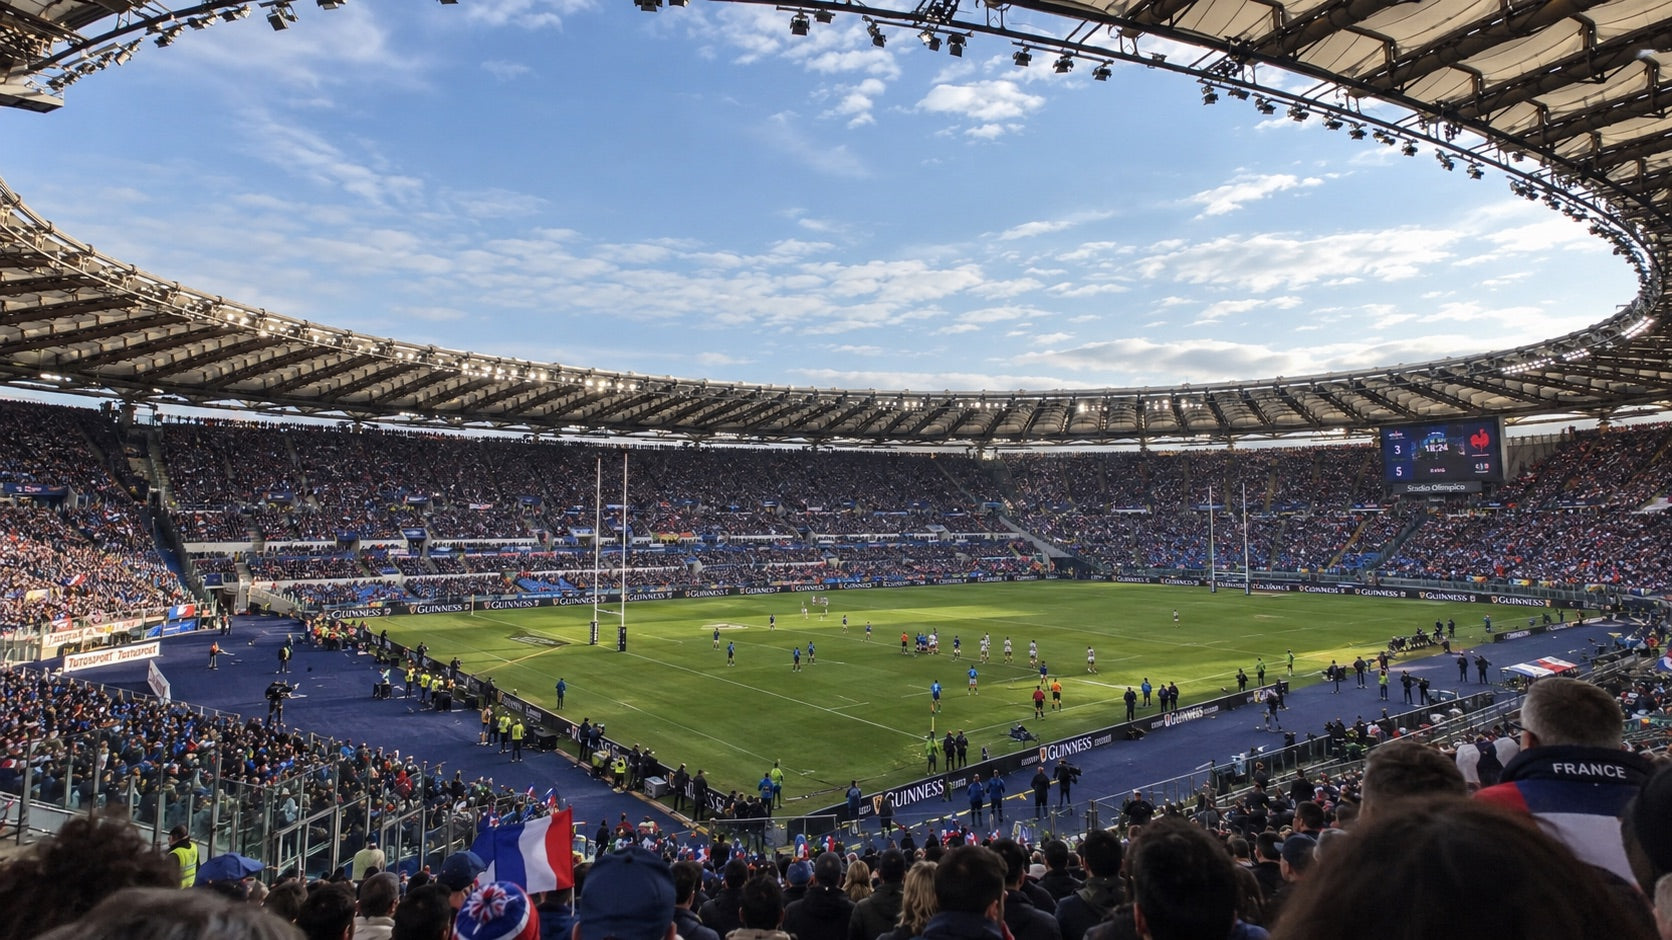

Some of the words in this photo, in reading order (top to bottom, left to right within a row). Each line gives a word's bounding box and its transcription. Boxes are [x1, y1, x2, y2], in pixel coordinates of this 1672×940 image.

[1395, 466, 1402, 477] 5
[1407, 484, 1430, 492] Stadio
[1431, 483, 1465, 492] Olimpico
[1498, 595, 1544, 606] GUINNESS
[417, 603, 463, 614] GUINNESS
[1047, 736, 1092, 761] GUINNESS
[1552, 762, 1627, 779] FRANCE
[884, 778, 944, 808] GUINNESS
